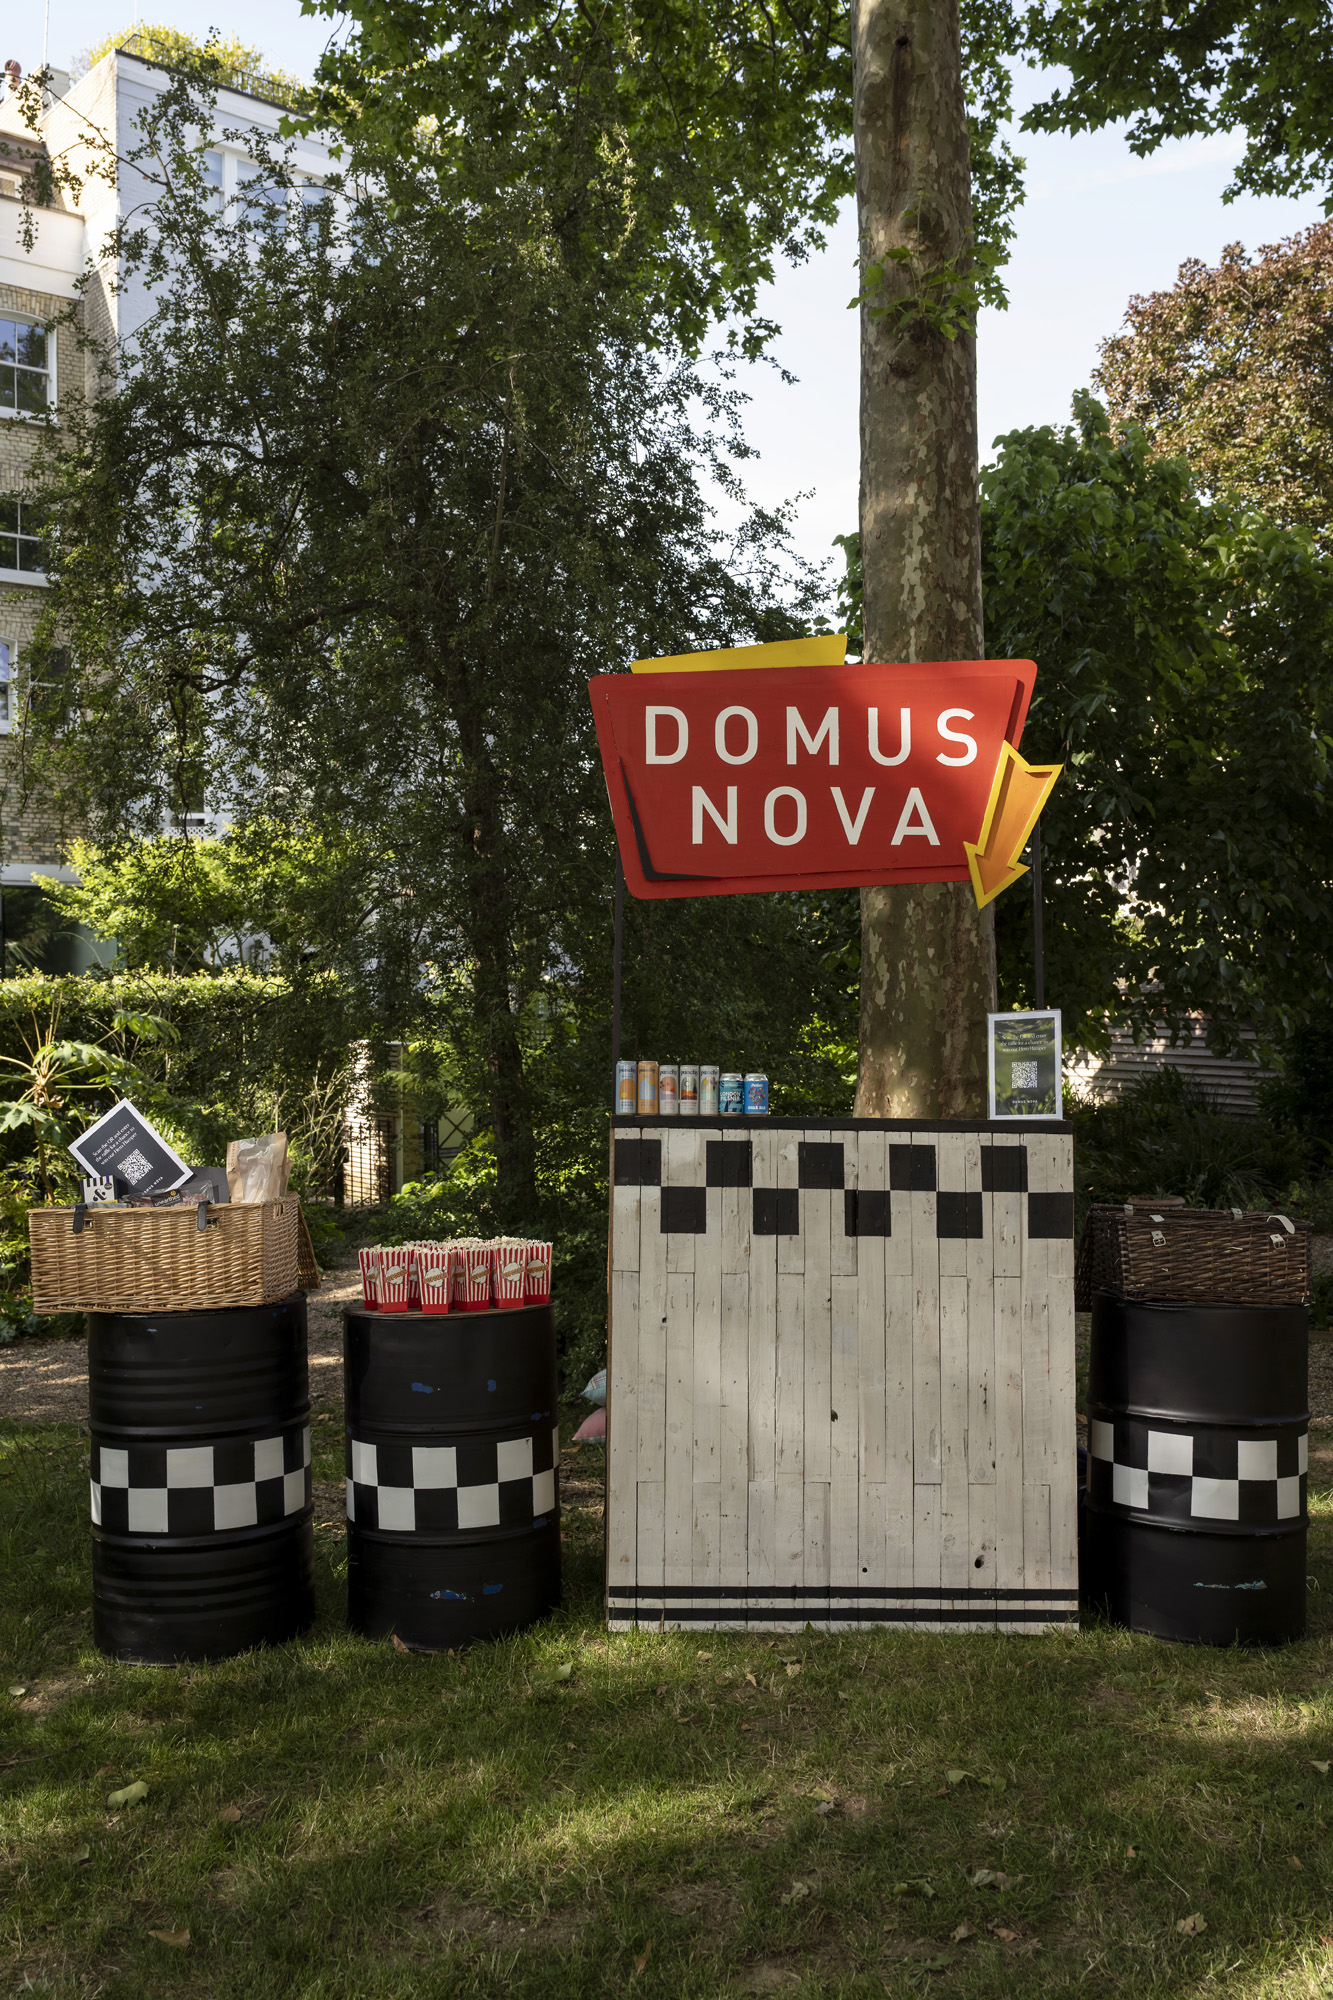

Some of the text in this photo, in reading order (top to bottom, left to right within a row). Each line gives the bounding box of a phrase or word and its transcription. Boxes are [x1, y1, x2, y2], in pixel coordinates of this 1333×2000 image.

[645, 705, 978, 767] DOMUS
[691, 785, 941, 846] NOVA
[92, 1148, 102, 1156] Scan
[120, 1124, 129, 1132] enter
[102, 1148, 110, 1157] raffle
[118, 1131, 130, 1142] chance
[114, 1144, 124, 1153] Hero
[122, 1132, 137, 1145] Hamper
[154, 1194, 180, 1206] unearthed
[423, 1272, 448, 1284] POPCORN
